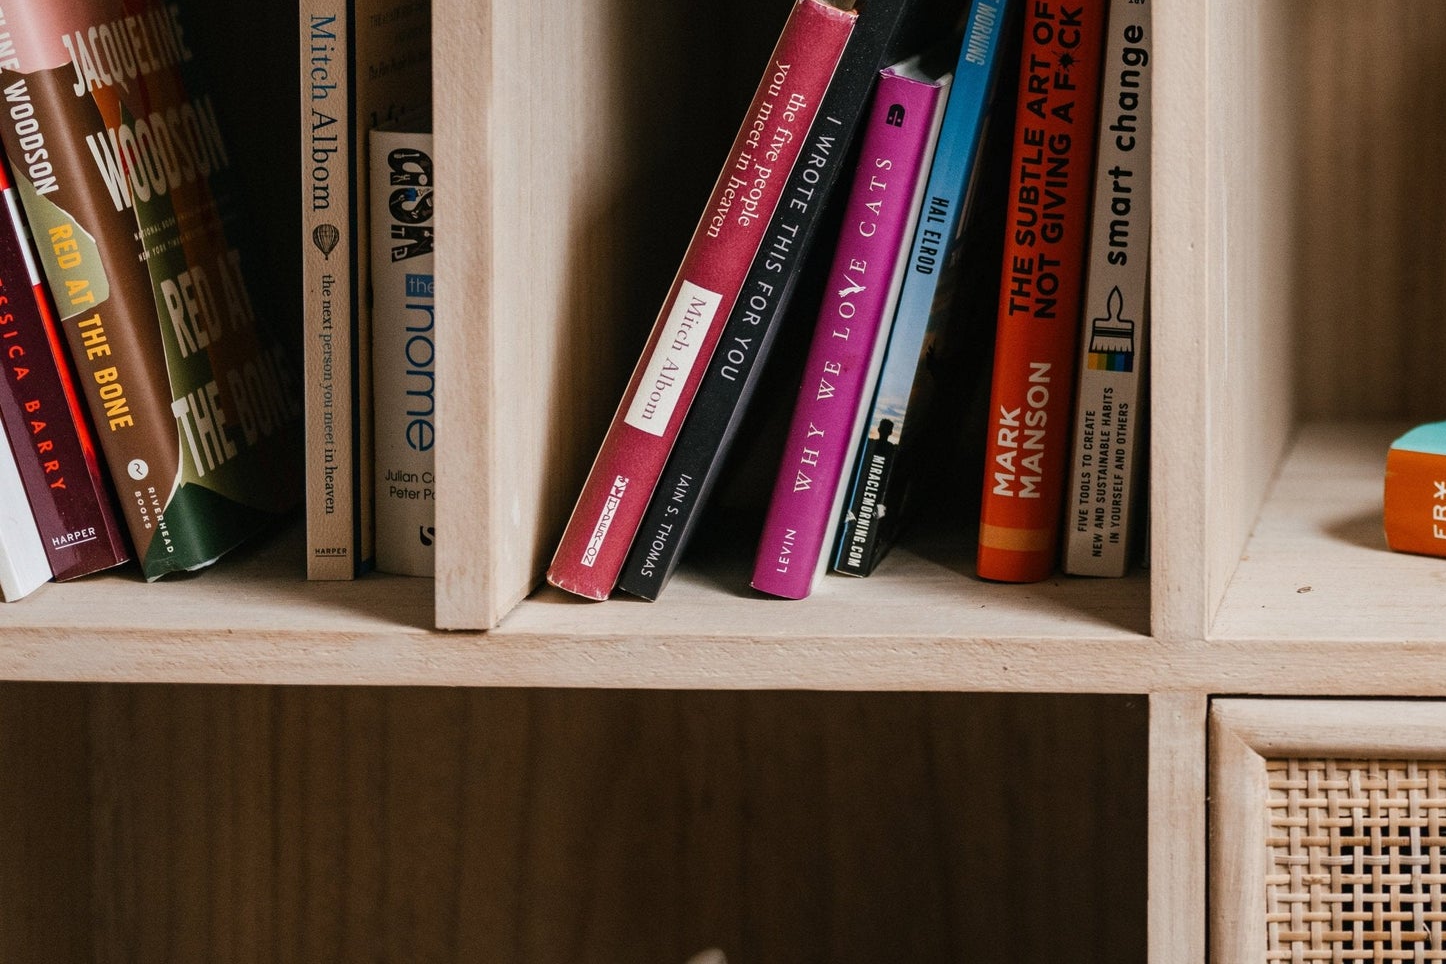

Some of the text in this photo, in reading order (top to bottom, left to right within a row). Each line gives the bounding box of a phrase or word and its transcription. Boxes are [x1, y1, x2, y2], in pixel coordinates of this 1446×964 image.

[61, 4, 192, 98] JACQUELINE
[965, 2, 997, 66] MORNING
[3, 79, 59, 196] WOODSON
[85, 94, 229, 212] WOODSON
[707, 61, 791, 238] you meet in heaven
[738, 93, 807, 227] the five people
[1009, 0, 1055, 316] THE SUBTLE ART OF
[1051, 100, 1075, 125] A
[1108, 24, 1149, 267] smart change
[916, 196, 950, 275] HAL ELROD
[1040, 134, 1072, 244] GIVING
[48, 223, 81, 271] RED
[65, 279, 94, 306] AT
[310, 13, 338, 515] Mitch Albom the next person you meet in heaven
[1033, 253, 1061, 319] NOT
[78, 314, 111, 361] THE
[160, 265, 222, 358] RED
[641, 116, 842, 577] I WROTE THIS FOR YOU IAIN S. THOMAS
[642, 296, 707, 420] Mitch Albom
[0, 278, 66, 490] SSICA BARRY
[94, 366, 134, 432] BONE
[776, 158, 893, 573] LEVIN WHY WE LOVE CATS
[171, 380, 237, 478] THE
[385, 469, 419, 484] Julian
[992, 404, 1021, 497] MARK
[1018, 362, 1052, 499] MANSON
[1077, 410, 1095, 532] FIVE TOOLS TO CREATE
[1092, 387, 1113, 557] NEW AND SUSTAINABLE HABITS
[1109, 403, 1129, 544] IN YOURSELF AND OTHERS
[52, 527, 96, 546] HARPER
[134, 491, 151, 529] BOOKS
[148, 486, 174, 553] RIVERHEAD
[389, 487, 420, 501] Peter
[583, 498, 616, 565] HYPERION
[847, 454, 886, 568] MIRACLEMORNING.COM
